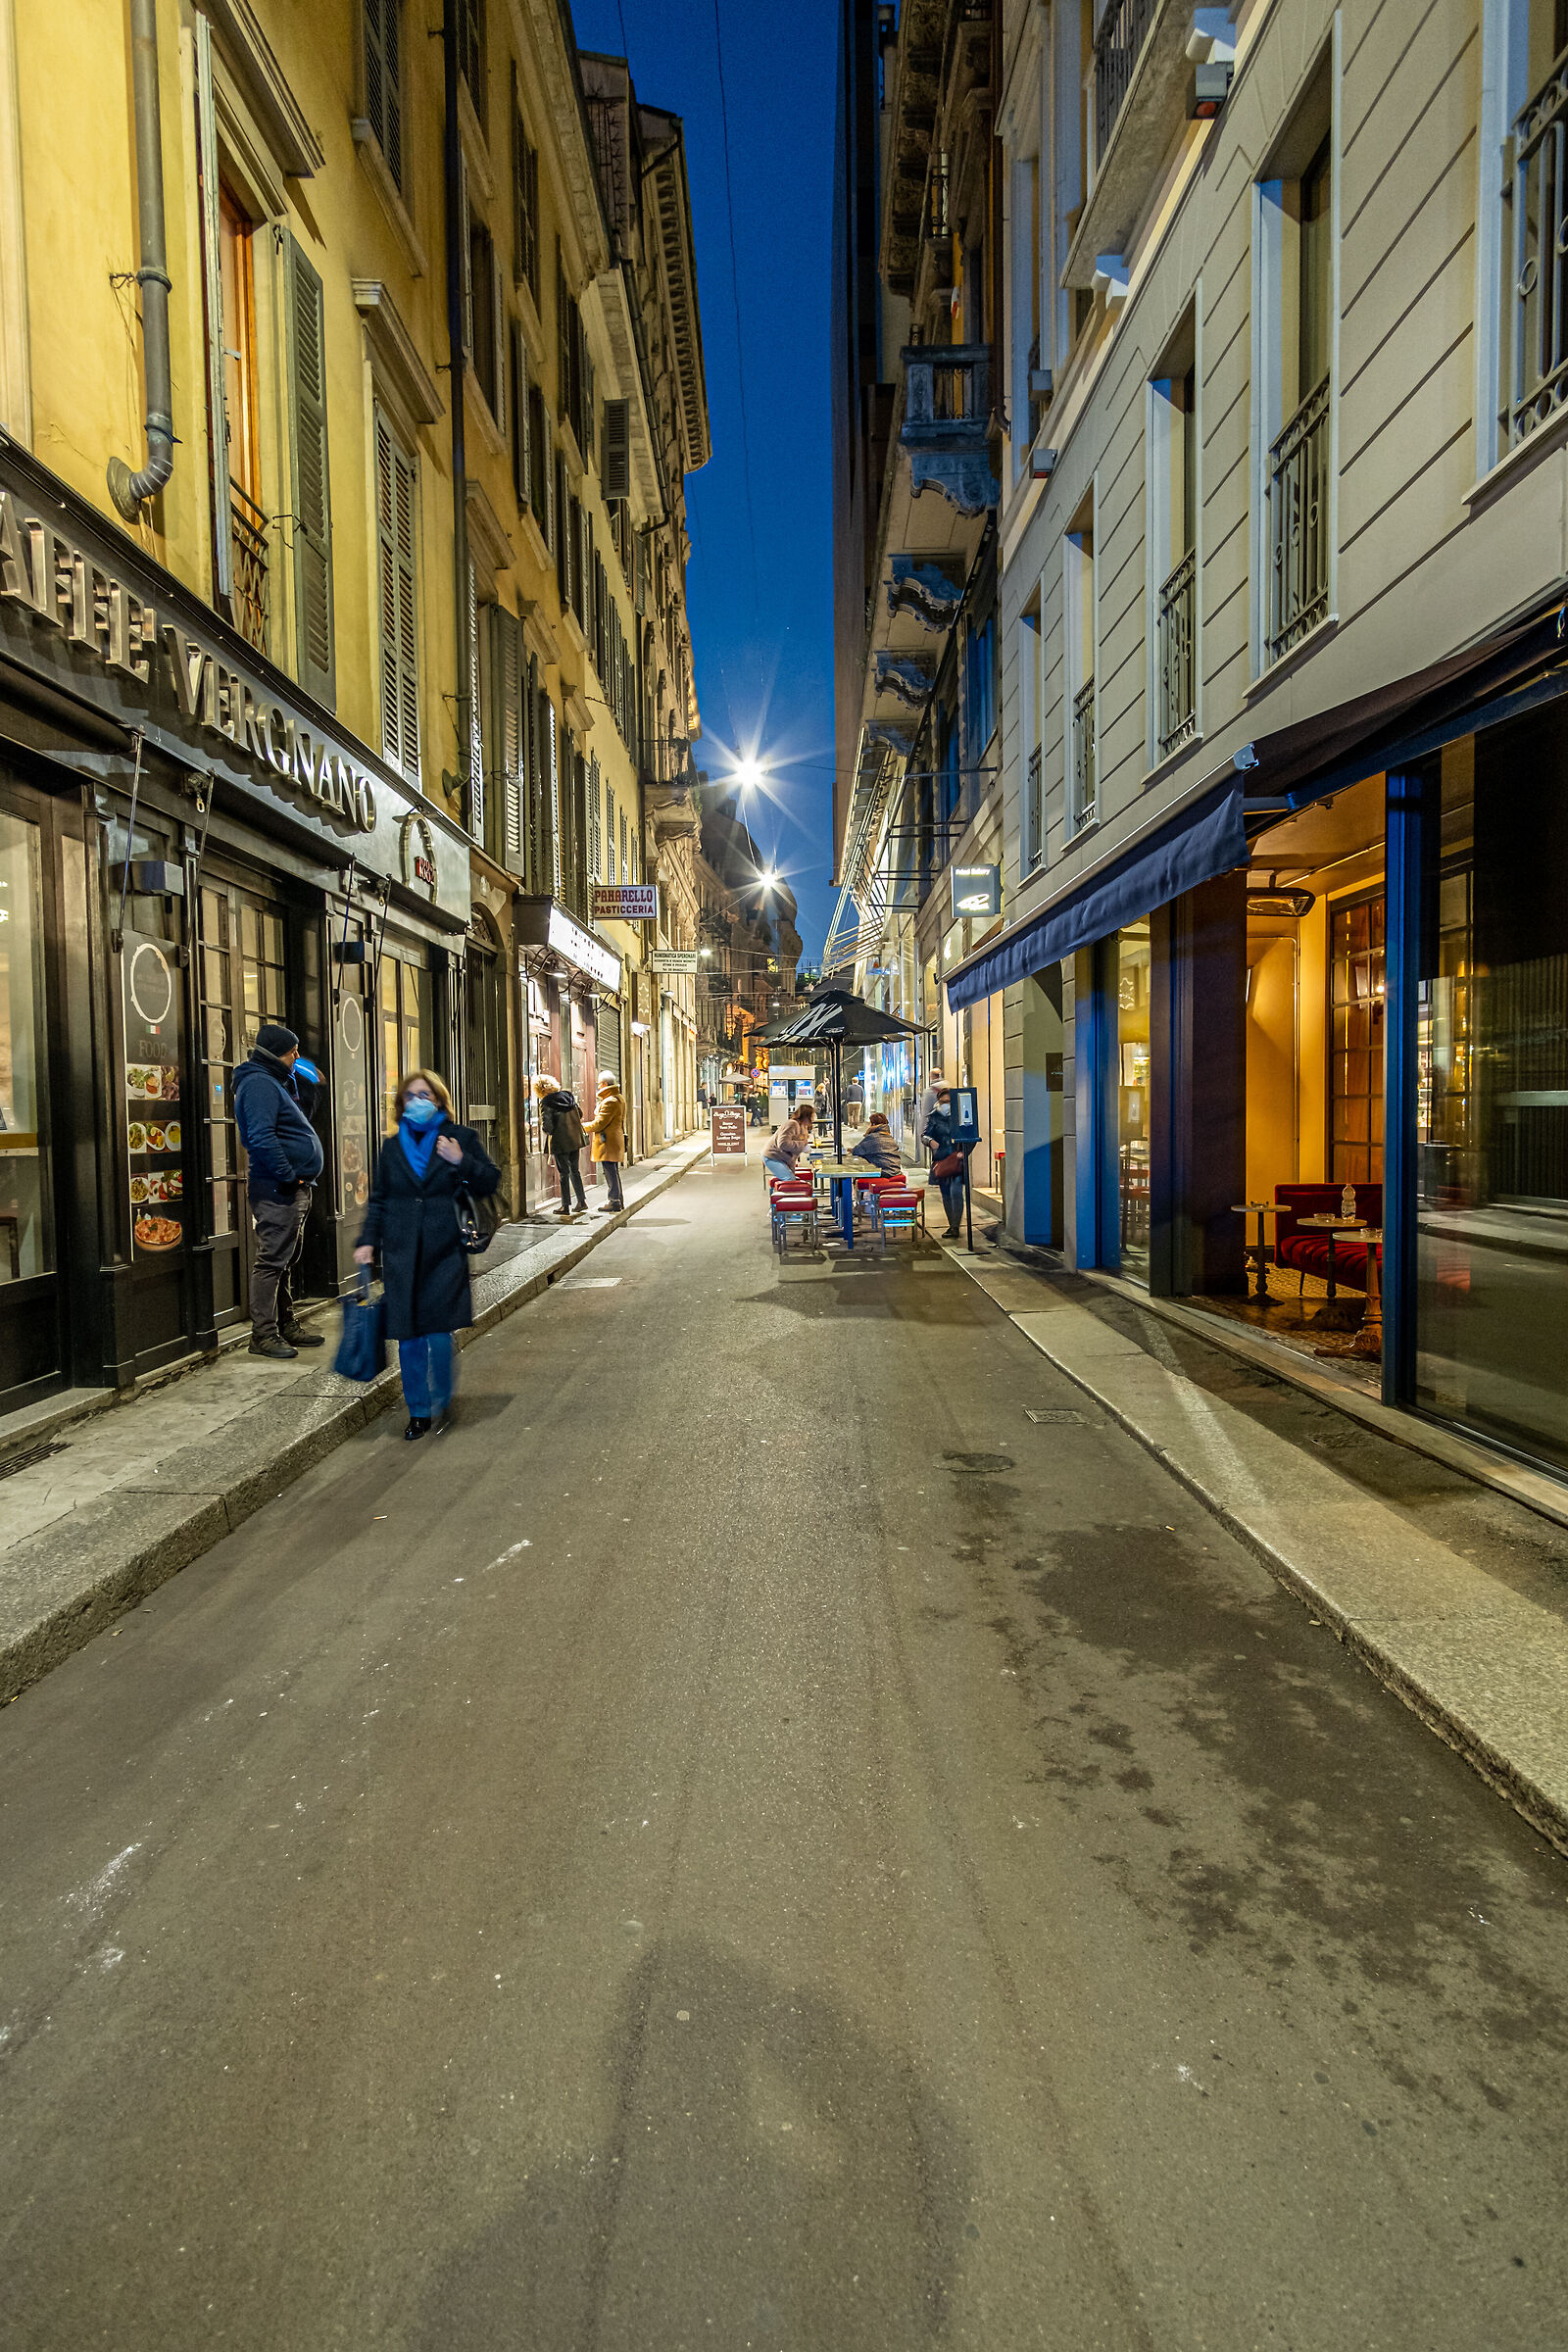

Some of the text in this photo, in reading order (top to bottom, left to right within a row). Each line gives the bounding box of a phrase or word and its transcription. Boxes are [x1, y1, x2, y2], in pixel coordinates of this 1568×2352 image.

[162, 624, 376, 833] VERGNANO
[594, 889, 654, 903] PANARELLO
[594, 905, 654, 914] PASTICCERIA
[138, 1040, 168, 1059] FOOD
